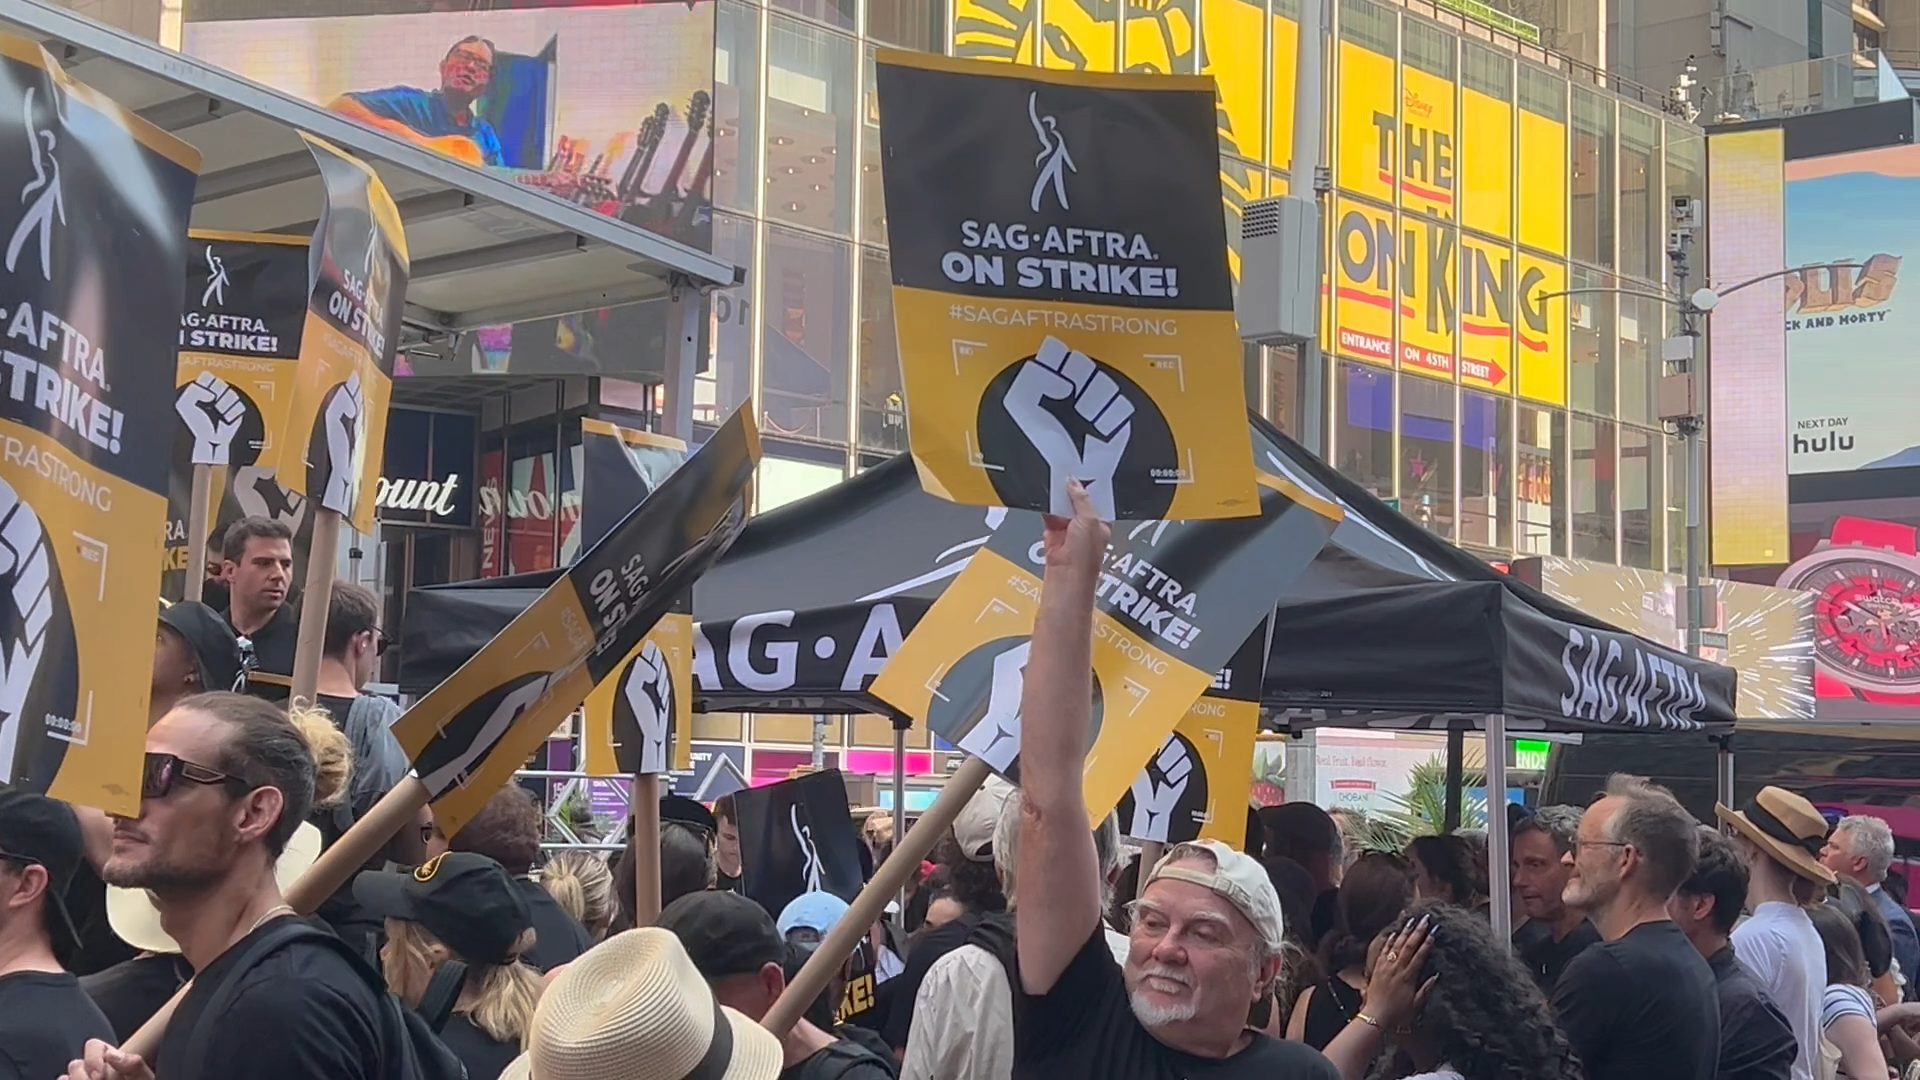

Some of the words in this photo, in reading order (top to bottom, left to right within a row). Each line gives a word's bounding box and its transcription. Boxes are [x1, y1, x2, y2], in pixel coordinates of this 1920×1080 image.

[1373, 110, 1453, 190] THE
[941, 251, 1005, 286] ON
[1016, 256, 1179, 298] STRIKE!
[1338, 210, 1415, 298] ON
[1426, 205, 1548, 337] KING
[328, 290, 353, 324] ON
[949, 303, 1178, 336] #SAGAFTRASTRONG
[1805, 316, 1835, 329] AND
[1839, 310, 1887, 326] MORTY
[190, 330, 279, 352] STRIKE!
[1341, 331, 1391, 355] ENTRANCE
[1404, 346, 1421, 362] ON
[1425, 355, 1450, 369] 45TH
[1461, 360, 1491, 379] STREET
[0, 350, 124, 455] TRIKE!
[1797, 418, 1826, 430] NEXT
[1827, 416, 1849, 428] DAY
[1793, 430, 1854, 454] hulu
[589, 568, 621, 613] ON
[1096, 570, 1202, 650] TRIKE!
